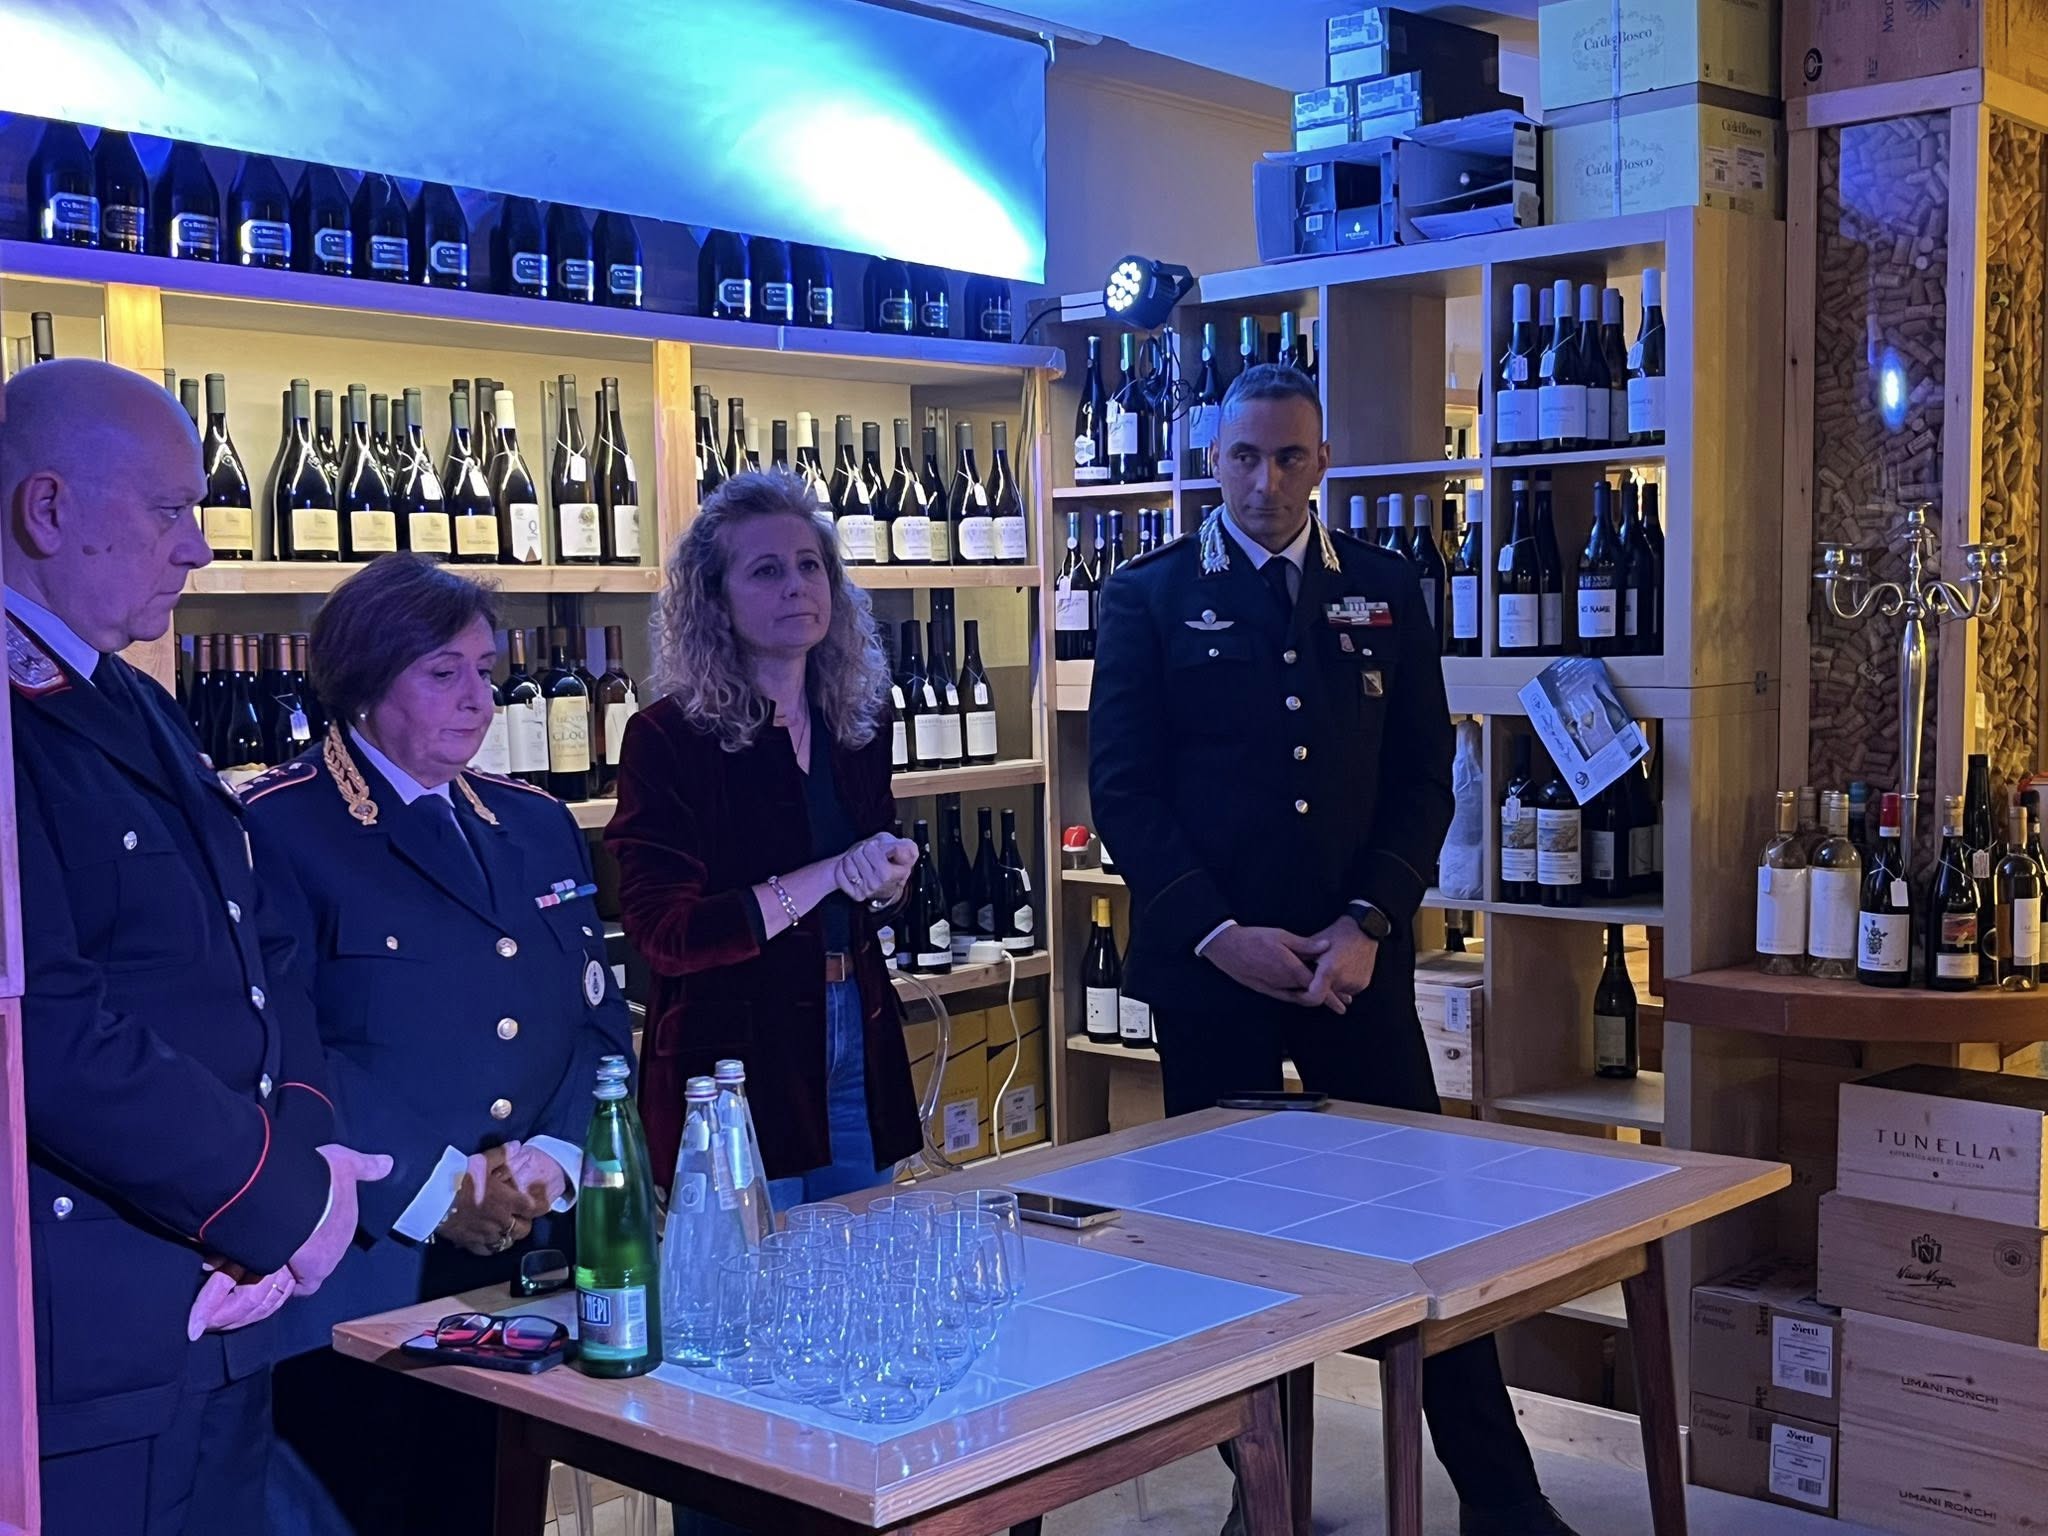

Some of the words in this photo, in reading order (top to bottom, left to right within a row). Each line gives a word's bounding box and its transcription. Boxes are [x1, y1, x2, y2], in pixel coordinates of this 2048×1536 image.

[1874, 1128, 2001, 1162] TUNELLA
[1901, 1376, 1943, 1393] UMANI
[1946, 1386, 1999, 1405] RONCHI
[1899, 1490, 1941, 1507] UMANI
[1944, 1500, 1997, 1520] RONCHI
